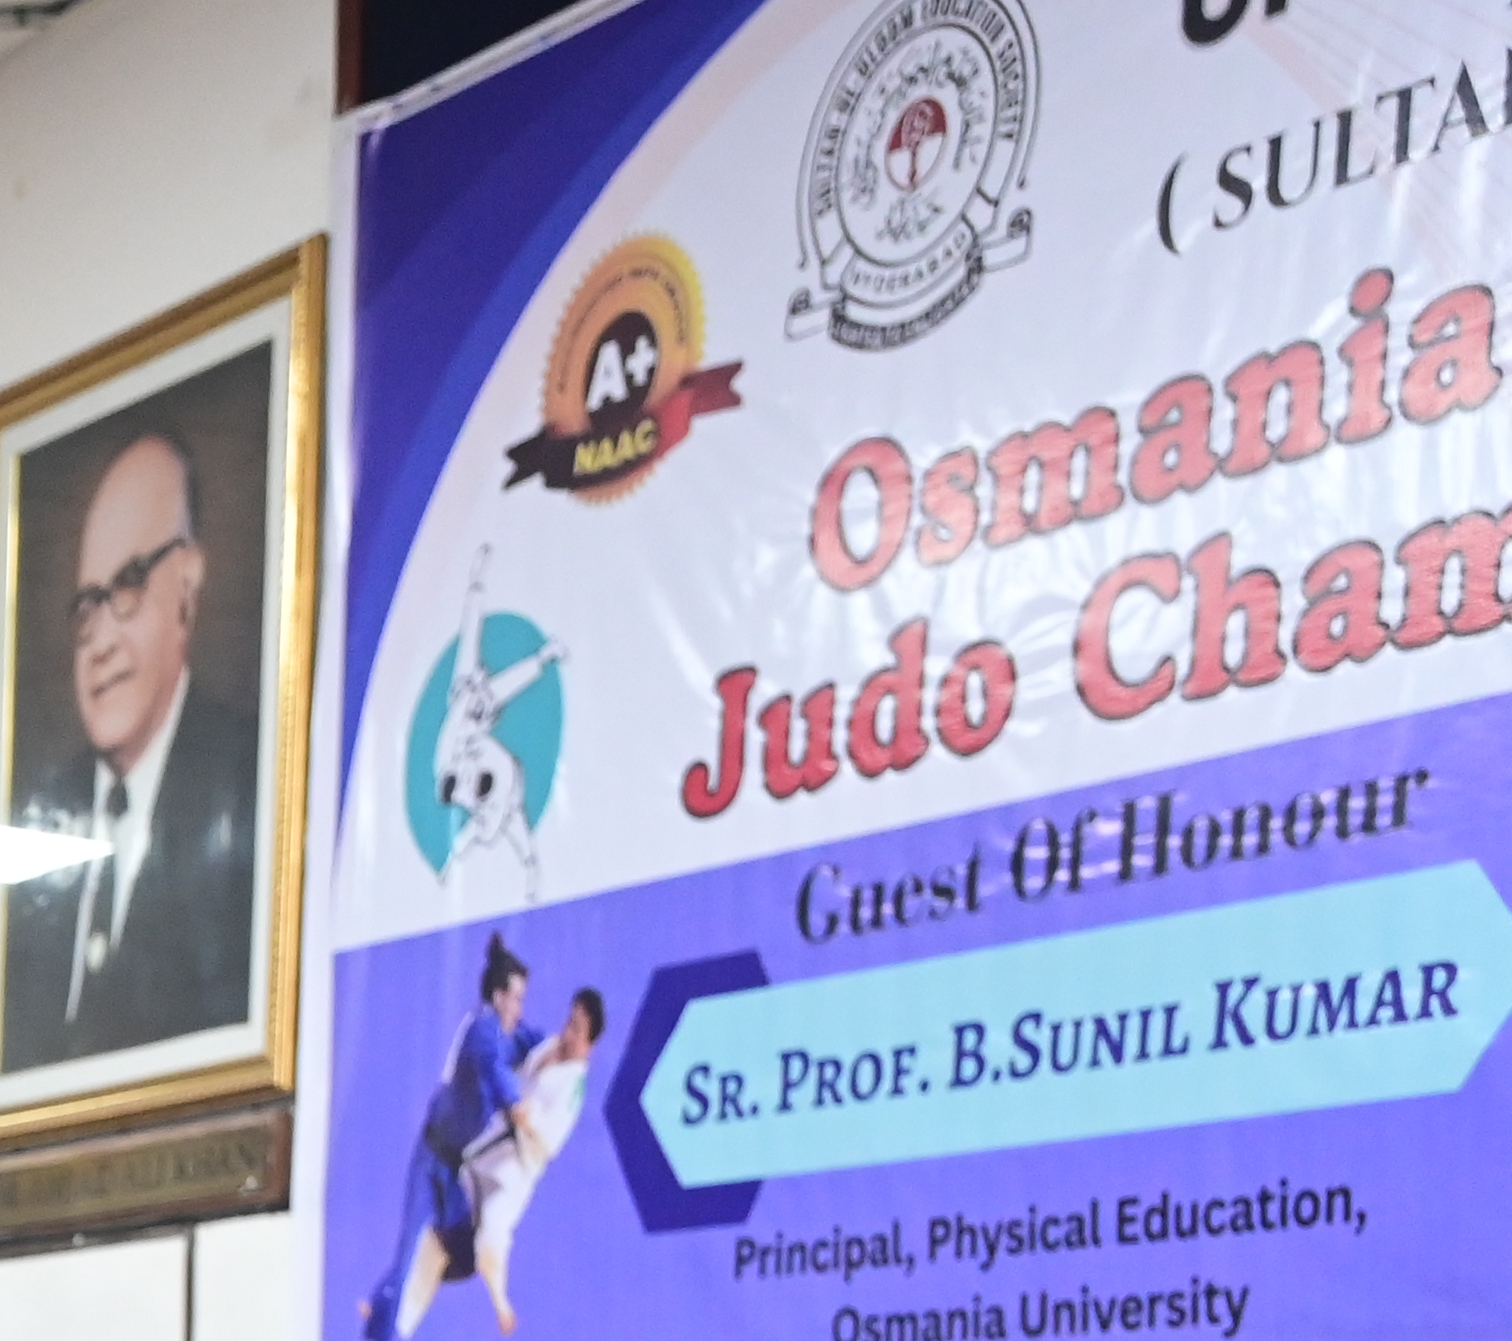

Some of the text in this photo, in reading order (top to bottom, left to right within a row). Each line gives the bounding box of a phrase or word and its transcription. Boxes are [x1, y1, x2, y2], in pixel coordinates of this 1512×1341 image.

[585, 334, 656, 413] A+
[571, 417, 658, 477] NAAC
[808, 267, 1504, 592] Osmania
[680, 617, 1019, 822] Judo
[794, 765, 1433, 948] Guest Of Honour
[732, 1175, 1369, 1282] Principal, Physical Education,
[1018, 1274, 1252, 1340] University
